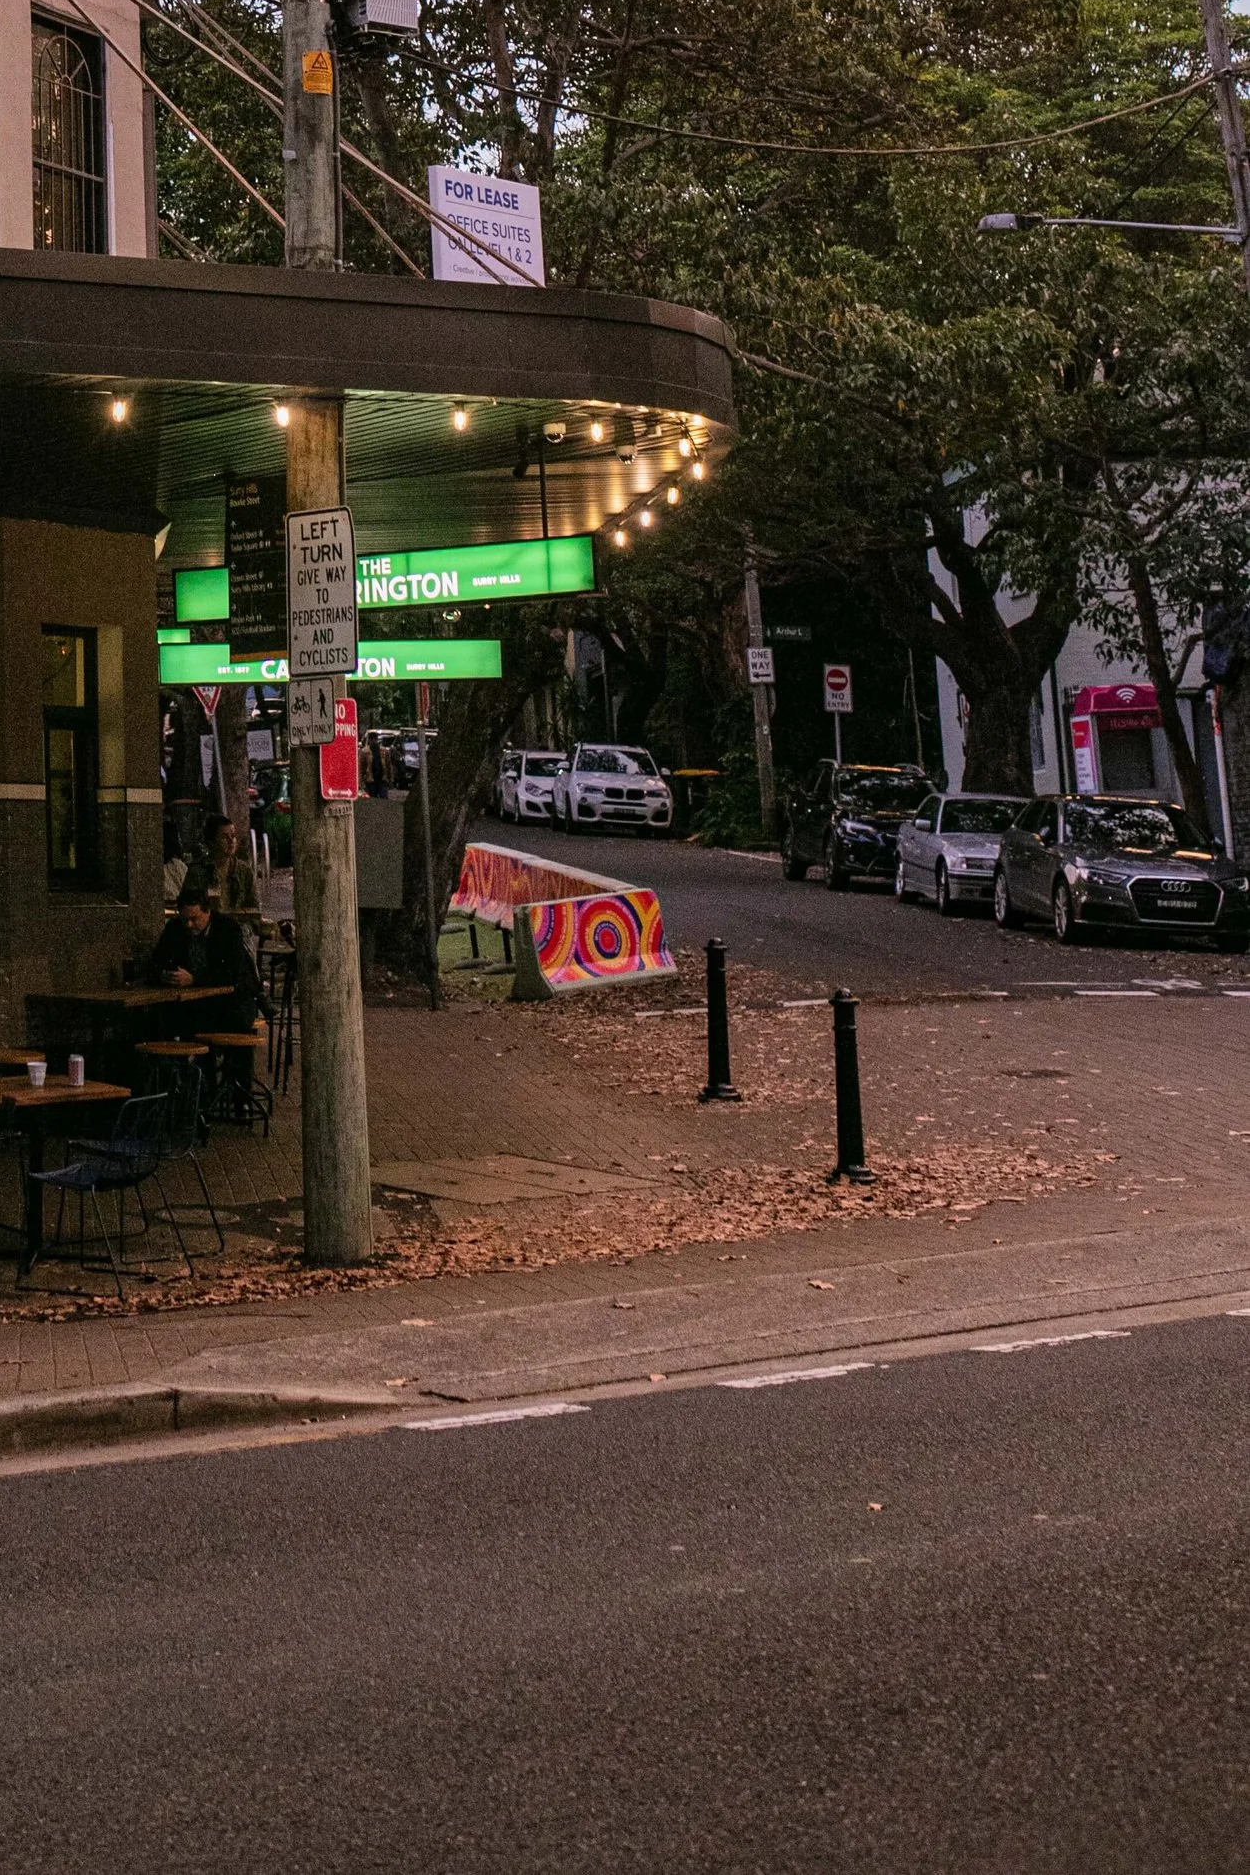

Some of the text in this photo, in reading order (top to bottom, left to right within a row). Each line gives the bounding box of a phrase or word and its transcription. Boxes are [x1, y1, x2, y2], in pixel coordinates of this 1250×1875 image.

[445, 179, 519, 210] FOR LEASE
[447, 213, 531, 243] OFFICE SUITES
[508, 246, 513, 260] 1
[515, 247, 523, 262] &
[525, 250, 532, 264] 2
[301, 518, 339, 541] LEFT
[300, 543, 343, 565] TURN
[297, 568, 320, 586] GIVE
[326, 566, 347, 583] WAY
[359, 558, 392, 576] THE
[316, 588, 329, 604] TO
[355, 571, 521, 604] RINGTON SURRY HILLS
[292, 606, 354, 626] PEDESTRIANS
[312, 628, 334, 645] AND
[300, 647, 349, 666] CYCLISTS
[751, 651, 769, 660] ONE
[406, 663, 426, 671] SURRY
[427, 663, 445, 671] HILLS
[751, 661, 770, 670] WAY
[827, 701, 850, 709] ENTRY
[292, 725, 332, 737] ONLY ONLY
[335, 724, 356, 737] PPING
